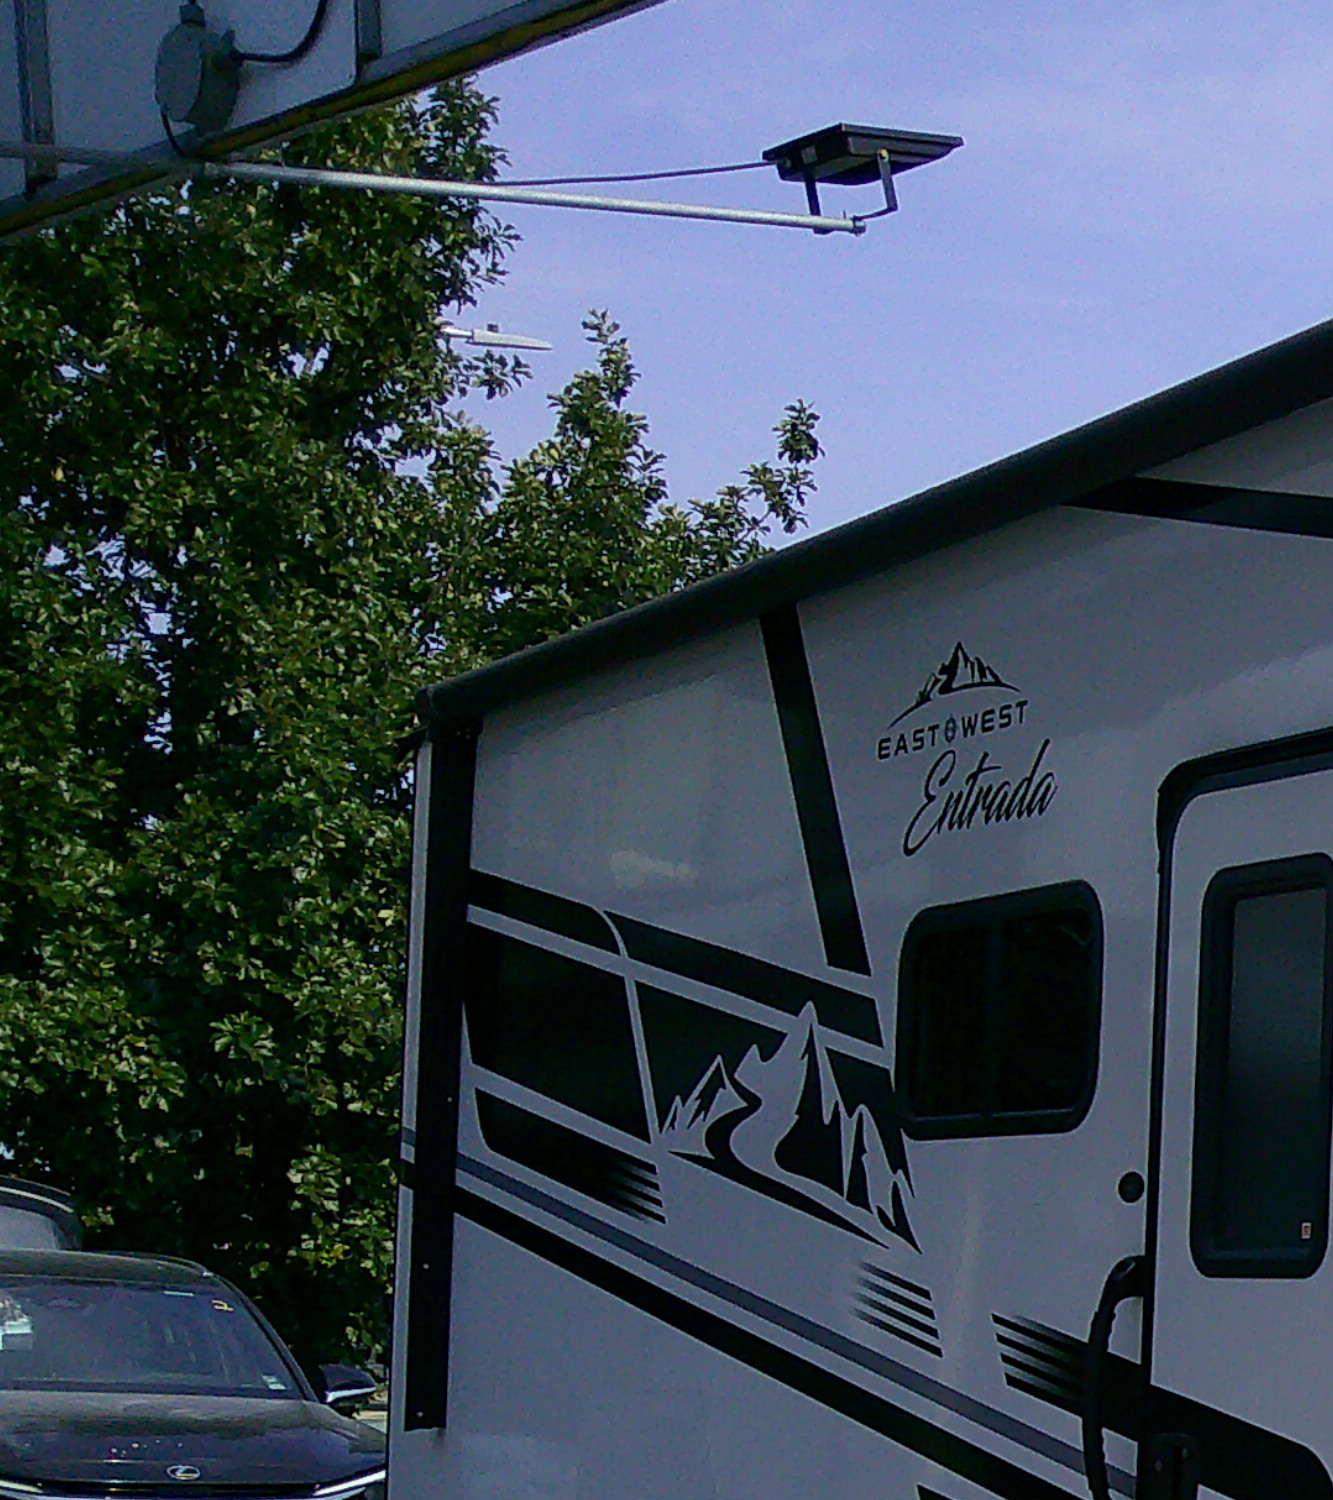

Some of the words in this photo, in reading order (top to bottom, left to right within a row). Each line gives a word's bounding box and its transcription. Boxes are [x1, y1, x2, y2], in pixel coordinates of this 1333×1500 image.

[877, 724, 939, 760] EAST
[961, 699, 1028, 738] WEST
[903, 738, 1058, 857] Entrada
